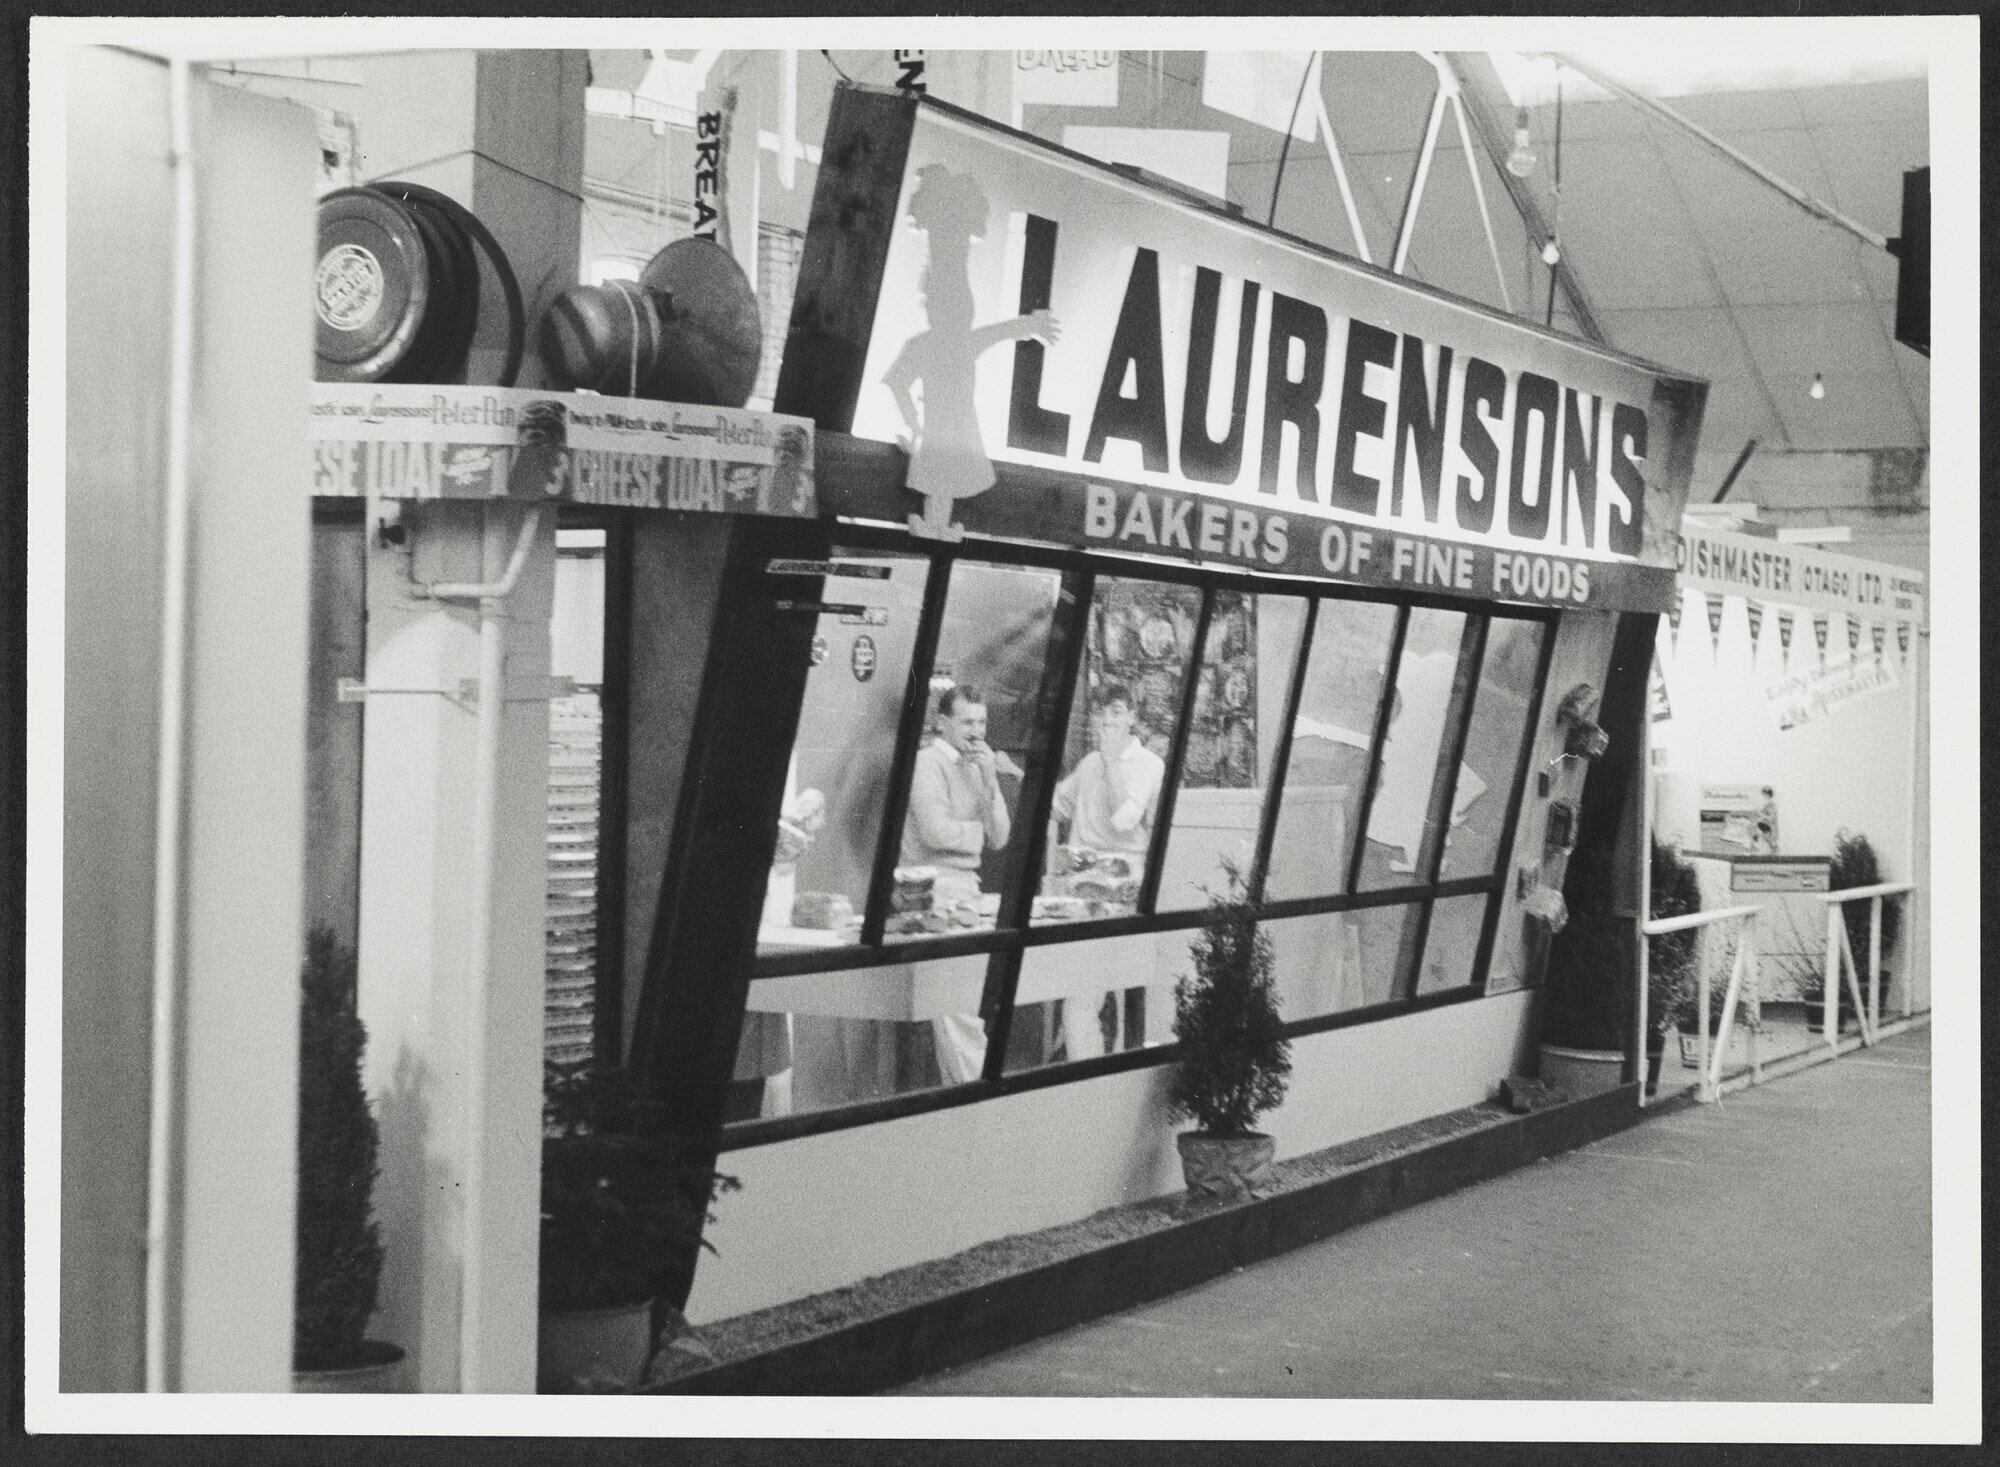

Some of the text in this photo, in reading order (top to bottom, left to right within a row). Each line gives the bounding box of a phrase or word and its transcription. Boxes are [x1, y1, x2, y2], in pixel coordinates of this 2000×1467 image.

[1006, 212, 1650, 556] LAURENSONS
[1084, 484, 1590, 602] BAKERS OF FINE FOODS
[1675, 534, 1792, 592] DISHMASTER
[1803, 564, 1850, 597] OTAGO
[1856, 572, 1884, 603] LTD
